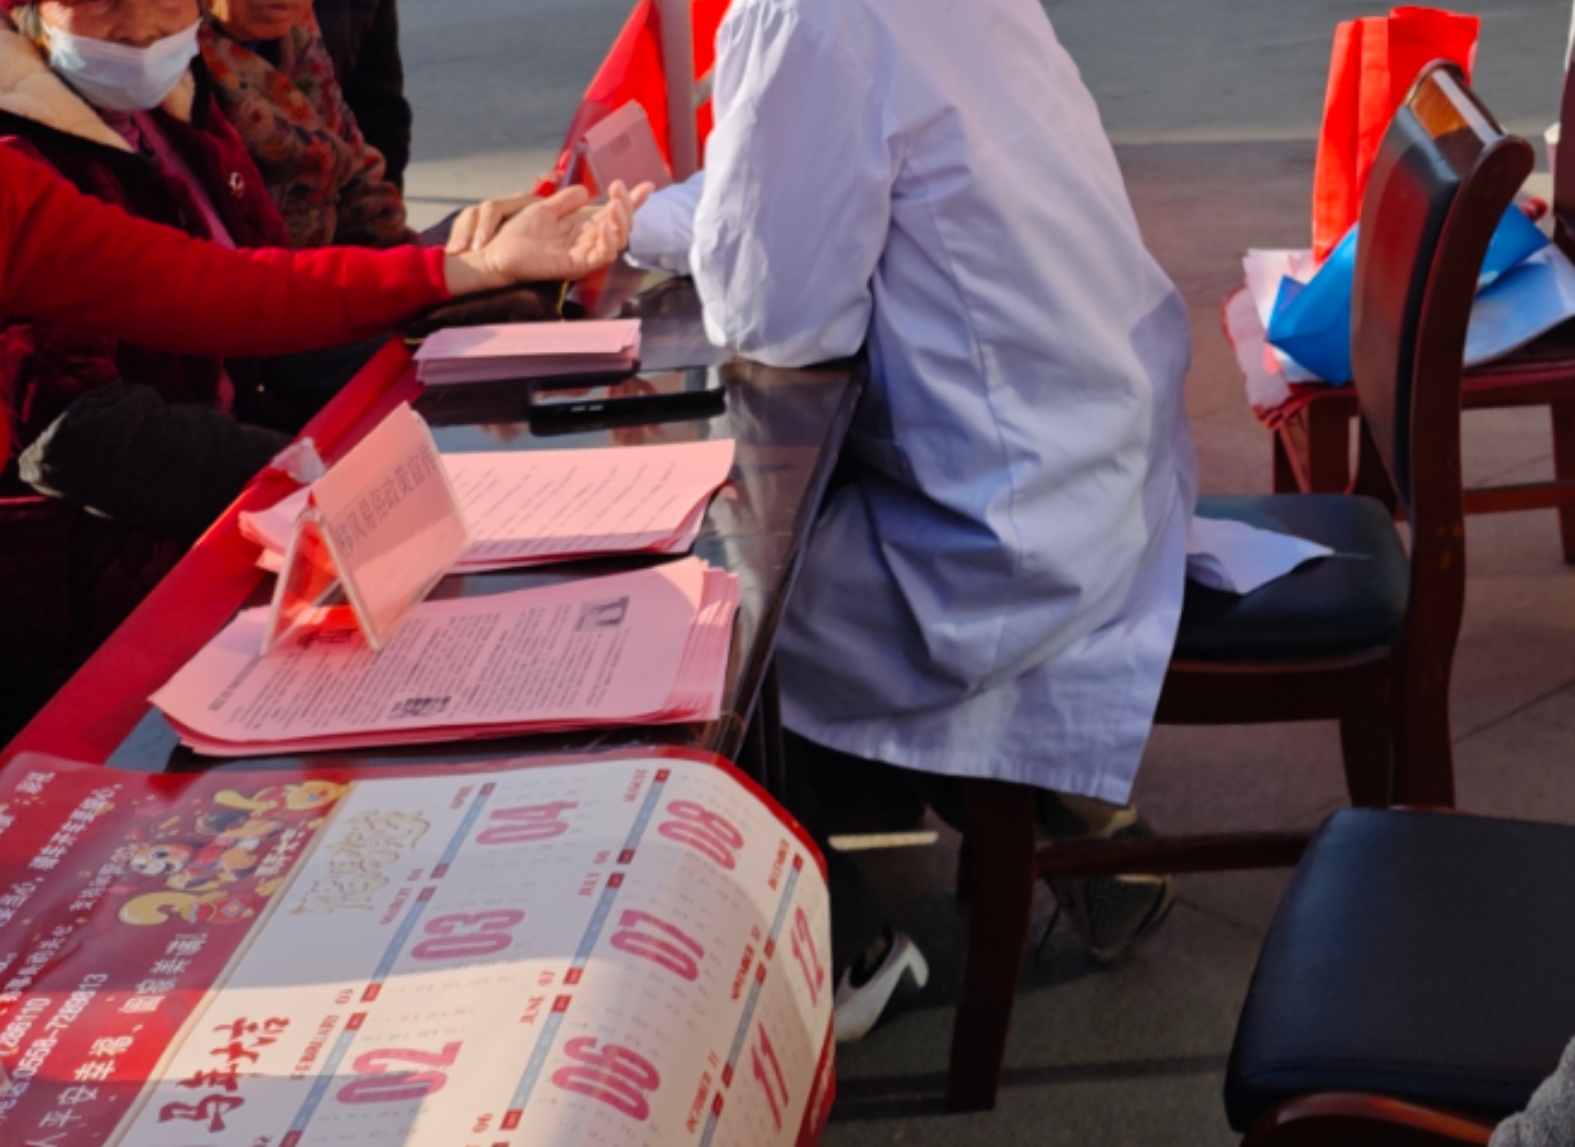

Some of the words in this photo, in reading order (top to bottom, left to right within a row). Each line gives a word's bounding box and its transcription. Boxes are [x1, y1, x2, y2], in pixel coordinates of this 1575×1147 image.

[475, 800, 581, 846] 04
[657, 799, 745, 871] 08
[410, 908, 526, 961] 03
[609, 908, 705, 982] 07
[790, 906, 825, 1007] 12
[334, 1039, 464, 1106] 02
[551, 1035, 661, 1123] 06
[750, 1020, 790, 1133] 11
